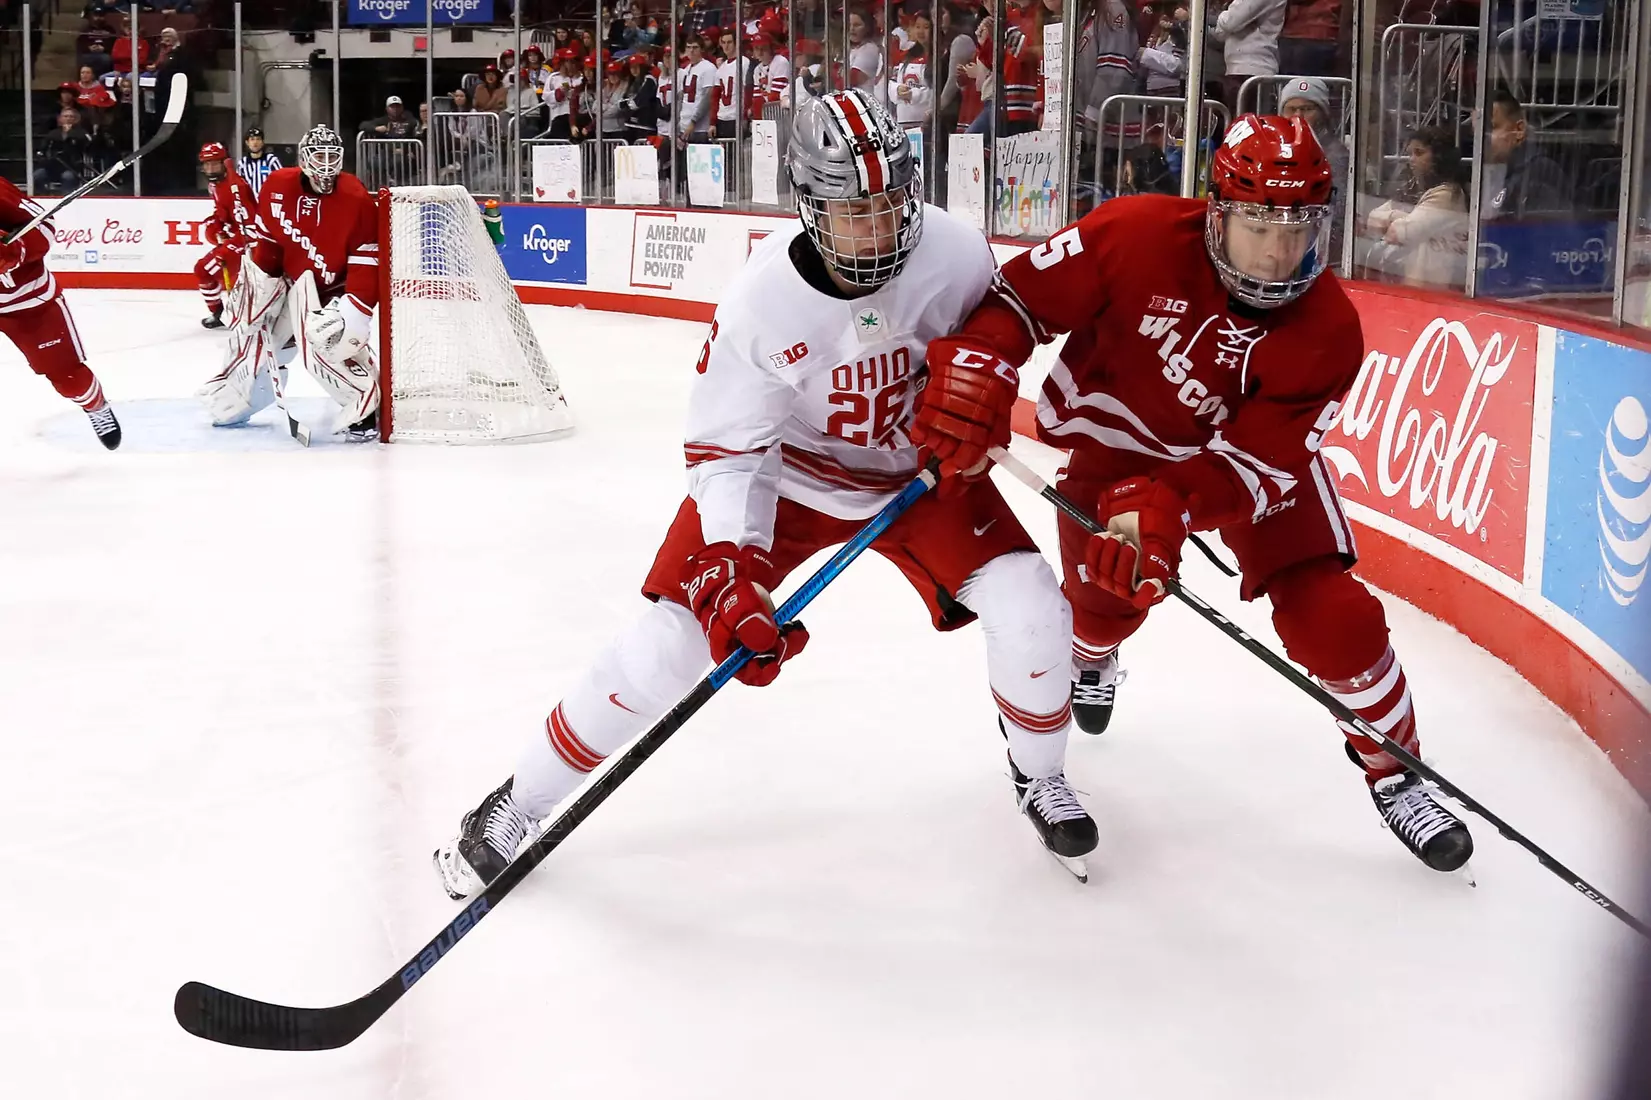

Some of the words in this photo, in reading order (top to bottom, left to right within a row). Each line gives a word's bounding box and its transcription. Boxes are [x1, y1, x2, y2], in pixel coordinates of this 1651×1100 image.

[359, 0, 410, 19] Kroger
[1265, 179, 1305, 188] CCM
[55, 228, 94, 250] eyes
[101, 218, 143, 244] Care
[270, 202, 336, 286] WISCONSIN
[523, 224, 571, 264] Kroger
[645, 224, 706, 244] AMERICAN
[1030, 226, 1084, 271] 5
[644, 242, 694, 262] ELECTRIC
[643, 260, 685, 280] POWER
[831, 346, 911, 393] OHIO
[951, 346, 1019, 385] CC
[826, 379, 910, 450] 26
[1113, 483, 1137, 495] CCM
[1251, 497, 1297, 525] CCM
[1573, 880, 1611, 908] CCM
[400, 895, 492, 991] BAUER
